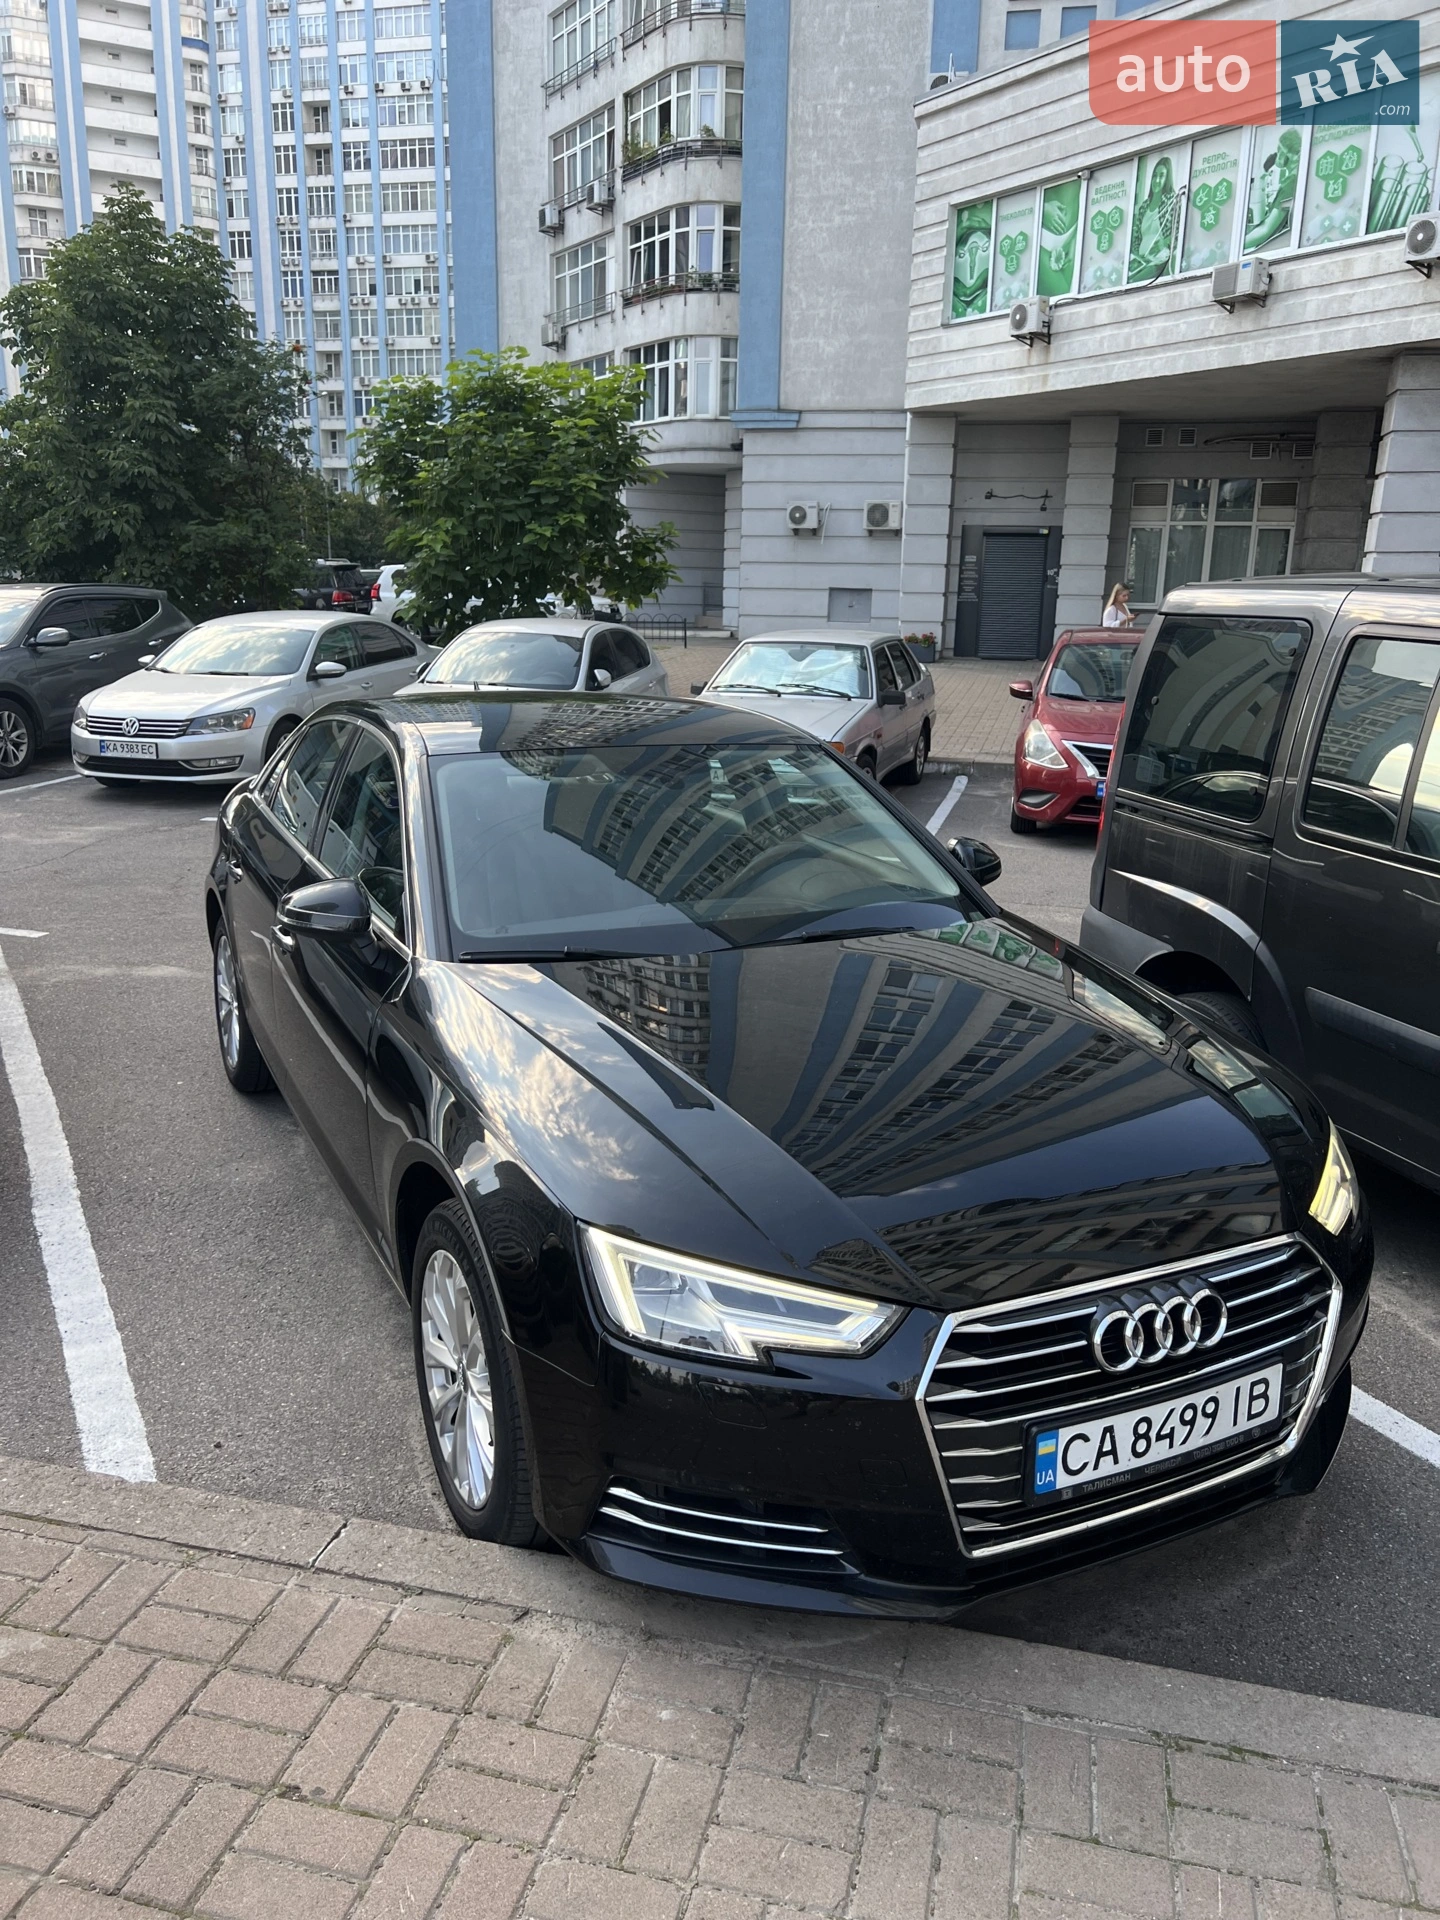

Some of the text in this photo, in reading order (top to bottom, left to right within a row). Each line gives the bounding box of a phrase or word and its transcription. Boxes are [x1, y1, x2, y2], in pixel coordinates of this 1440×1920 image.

[1202, 151, 1230, 165] РЕПРО-
[1192, 159, 1238, 179] ДУКТОЛОГІЯ
[1094, 180, 1125, 195] ВЕДЕННЯ
[1091, 189, 1127, 206] ВАГІТНОСТІ
[106, 742, 154, 755] KA 9383 EC
[1062, 1376, 1270, 1477] CA 8499 IB
[1036, 1469, 1055, 1486] UA
[1082, 1472, 1132, 1493] ТАЛИСМАН
